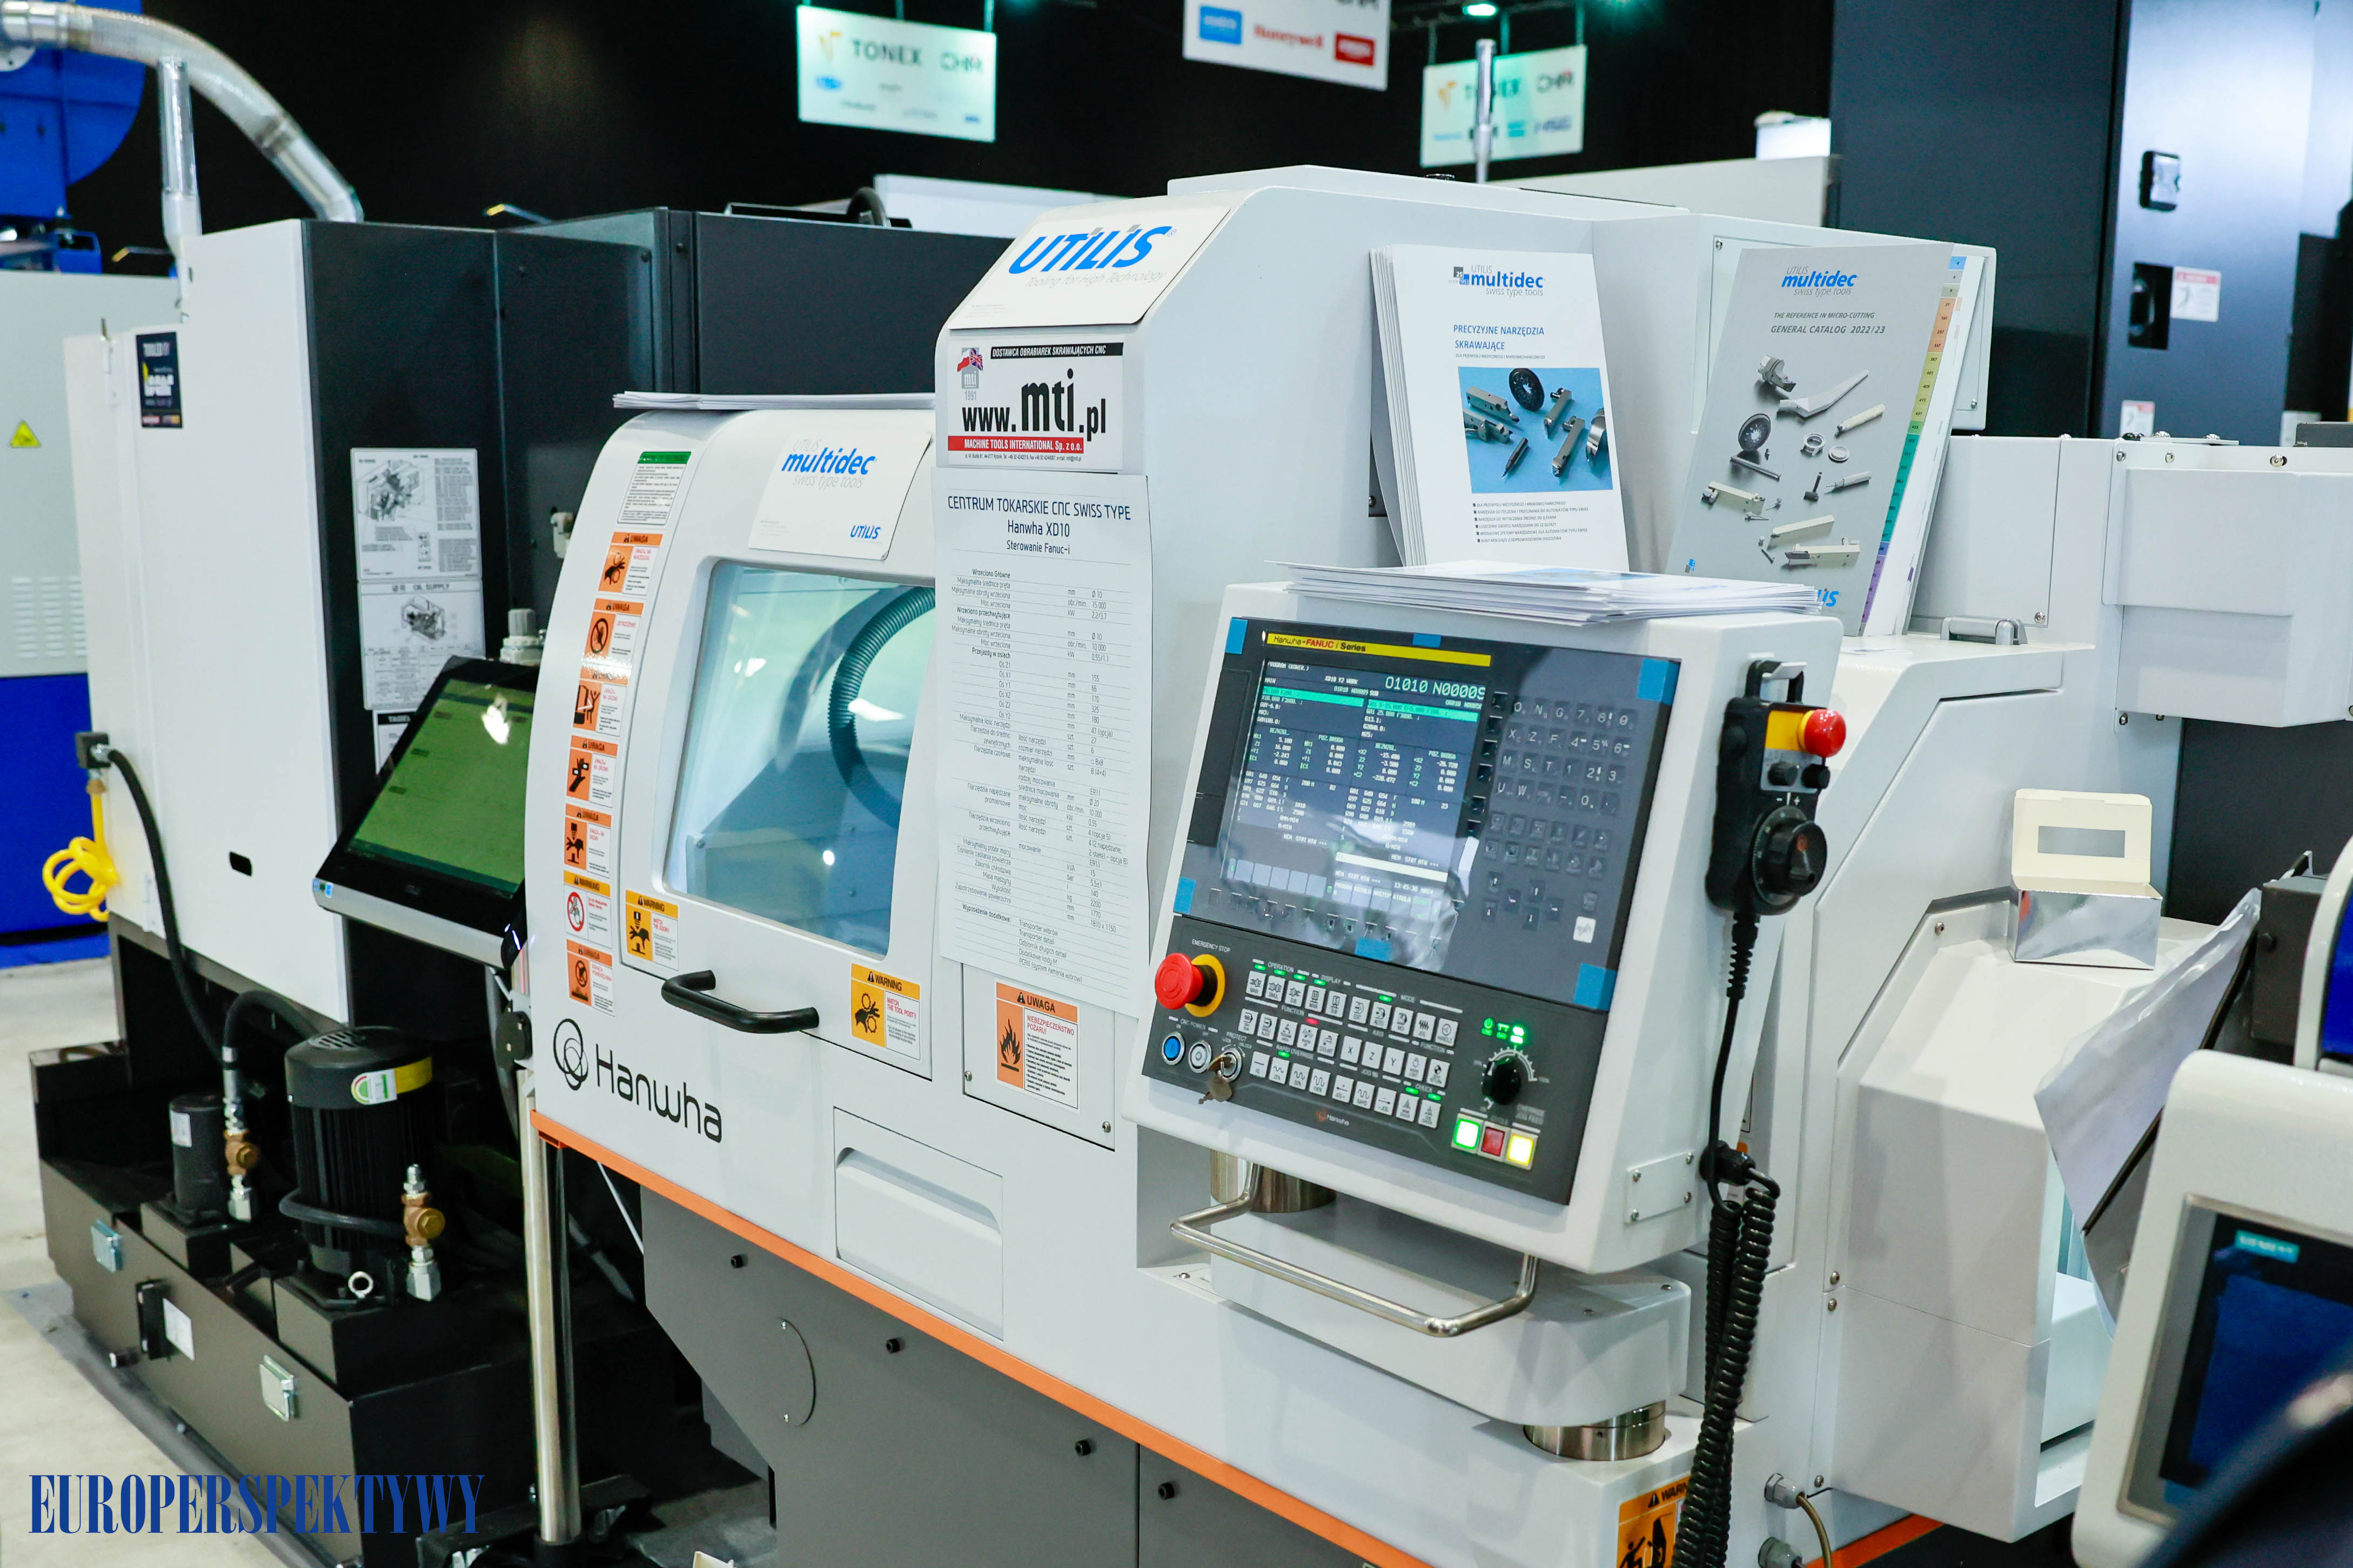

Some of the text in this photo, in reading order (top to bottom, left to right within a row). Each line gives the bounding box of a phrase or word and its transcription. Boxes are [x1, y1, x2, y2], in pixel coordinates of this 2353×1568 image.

[1471, 265, 1492, 274] UTILIS
[1786, 265, 1809, 274] UTILIS
[1471, 271, 1544, 288] multidec
[1781, 270, 1858, 287] multidec
[1507, 288, 1523, 297] type
[1815, 288, 1832, 297] type
[1453, 324, 1544, 337] PRECYZYJNE NARZĘDZIA
[1771, 325, 1806, 333] GENERAL
[1810, 325, 1846, 333] CATALOG
[993, 345, 1106, 358] DOSTAWCA OBRABIAREK SKRAWAJĄCYCH CNC
[1455, 340, 1505, 352] SKRAWAJĄCE
[964, 371, 977, 386] mti
[964, 391, 977, 400] 1991
[962, 368, 1106, 442] www.mti.pl
[964, 439, 989, 449] MACHINE
[990, 439, 1008, 449] TOOLS
[1009, 440, 1054, 450] INTERNATIONAL
[1055, 441, 1065, 452] Sp.
[1071, 442, 1082, 451] o.o.
[781, 447, 876, 475] multidec
[793, 475, 864, 490] swiss type tools
[948, 496, 1131, 520] CENTRUM TOKARSKIE CNC SWISS TYPE
[850, 524, 882, 539] UTILIS
[1008, 520, 1070, 537] Hanwha XD10
[1007, 540, 1070, 555] Sterowanie Fanuc-i
[973, 569, 1010, 579] Wrzeciono Główne
[957, 607, 1010, 620] Wrzeciono przechwytujące
[1091, 611, 1107, 620] 2.2/3.7
[973, 647, 992, 658] Przejazdy
[997, 651, 1010, 659] osiach
[1340, 642, 1366, 652] Series
[1091, 716, 1100, 724] 180
[1535, 705, 1543, 715] N
[1578, 710, 1585, 718] 7
[1598, 712, 1606, 723] 8
[1097, 729, 1113, 738] (opcja)
[1509, 730, 1622, 753] X Z F 4 5 6
[1503, 755, 1616, 781] M S T 1 2 3
[1498, 783, 1506, 793] U
[1517, 785, 1527, 796] W
[1090, 900, 1101, 909] 2200
[1091, 910, 1101, 918] 1770
[1019, 919, 1042, 932] Transporter
[1091, 920, 1101, 928] 1810
[1192, 939, 1231, 953] EMERGENCY STOP
[1268, 961, 1294, 973] OPERATION
[875, 974, 902, 991] WARNING
[887, 998, 900, 1007] WATCH
[1027, 995, 1056, 1013] UWAGA
[894, 1006, 904, 1015] TOOL
[1281, 1005, 1305, 1017] FUNCTION
[1027, 1015, 1075, 1036] NIEBEZPIECZEŃSTWO
[1027, 1023, 1047, 1035] POŻARU!
[1226, 1031, 1247, 1042] PROTECT
[1348, 1046, 1353, 1054] X
[1369, 1052, 1375, 1060] Z
[1391, 1058, 1397, 1066] Y
[596, 1044, 722, 1143] Hanwha
